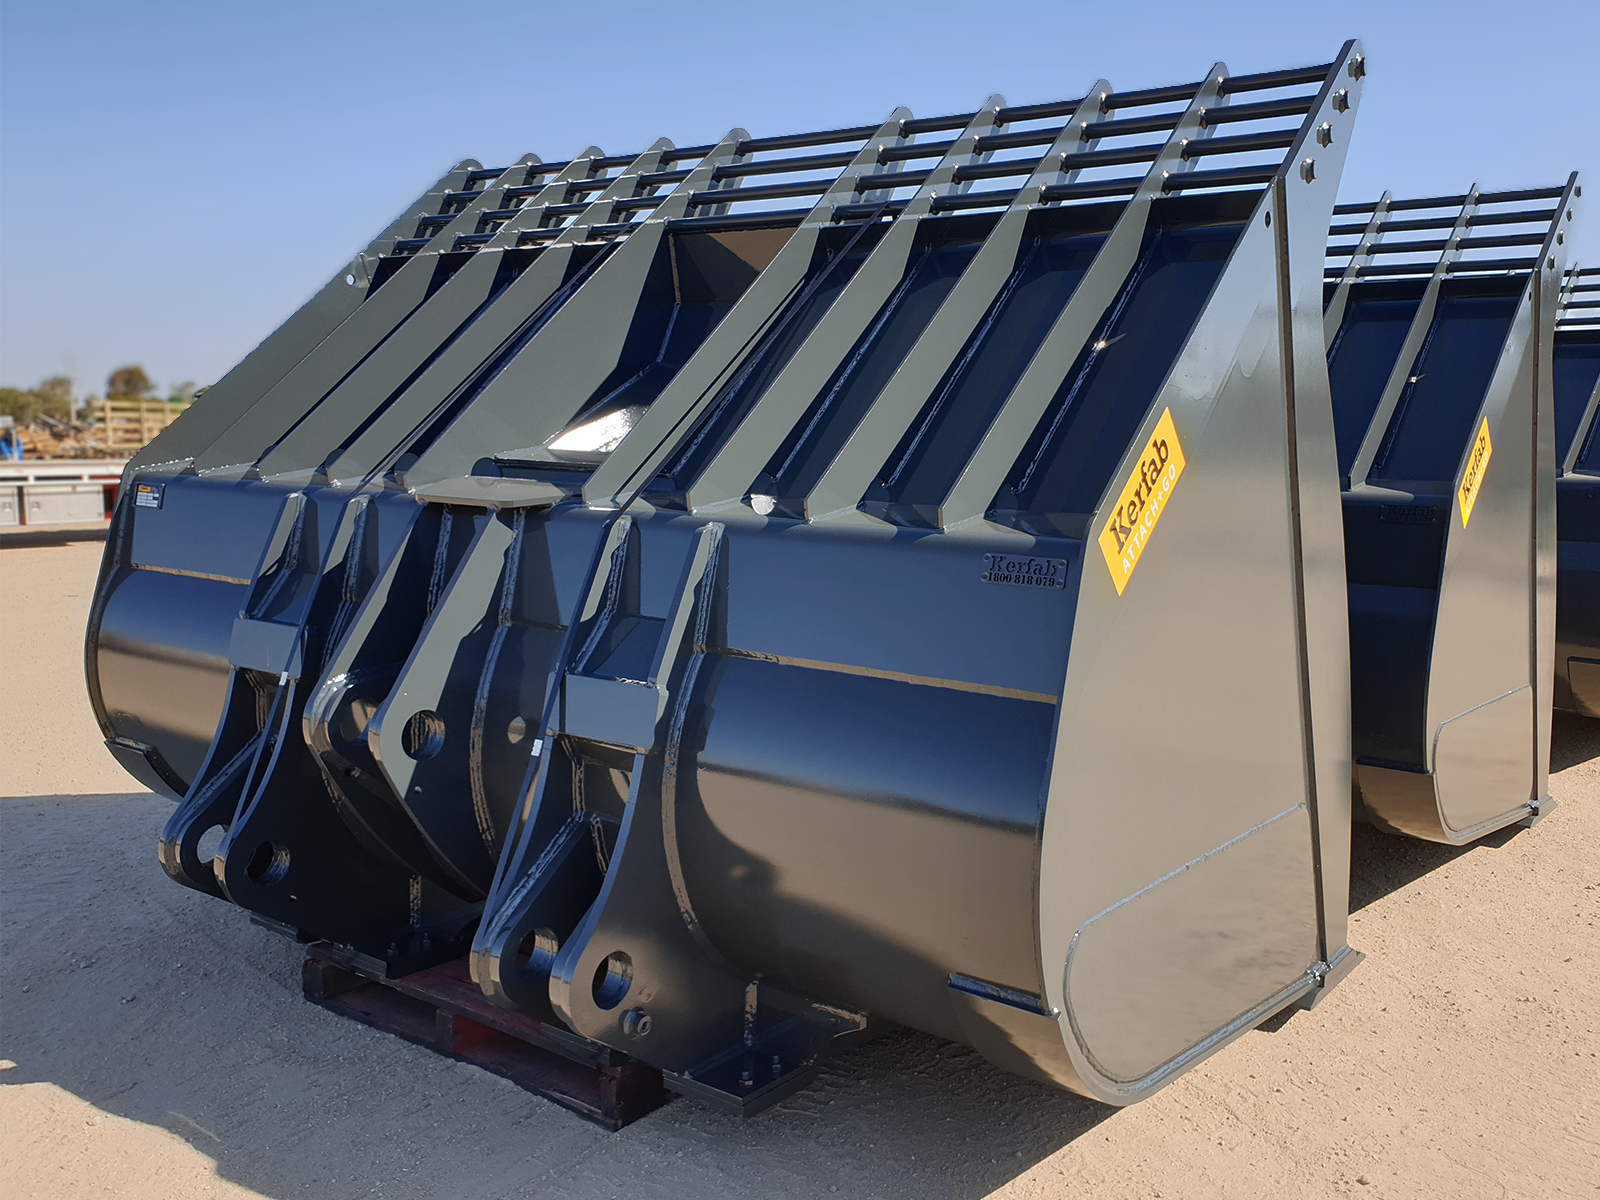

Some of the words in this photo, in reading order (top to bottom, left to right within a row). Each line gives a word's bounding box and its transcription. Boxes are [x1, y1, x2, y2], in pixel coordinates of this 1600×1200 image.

[1109, 438, 1170, 556] Kerfab
[1463, 435, 1486, 504] Kerfab
[1122, 464, 1176, 575] ATTACH+GO
[988, 572, 1012, 584] 1800
[1014, 575, 1033, 586] 818
[1035, 577, 1055, 587] 079
[990, 556, 1057, 577] Kerfab
